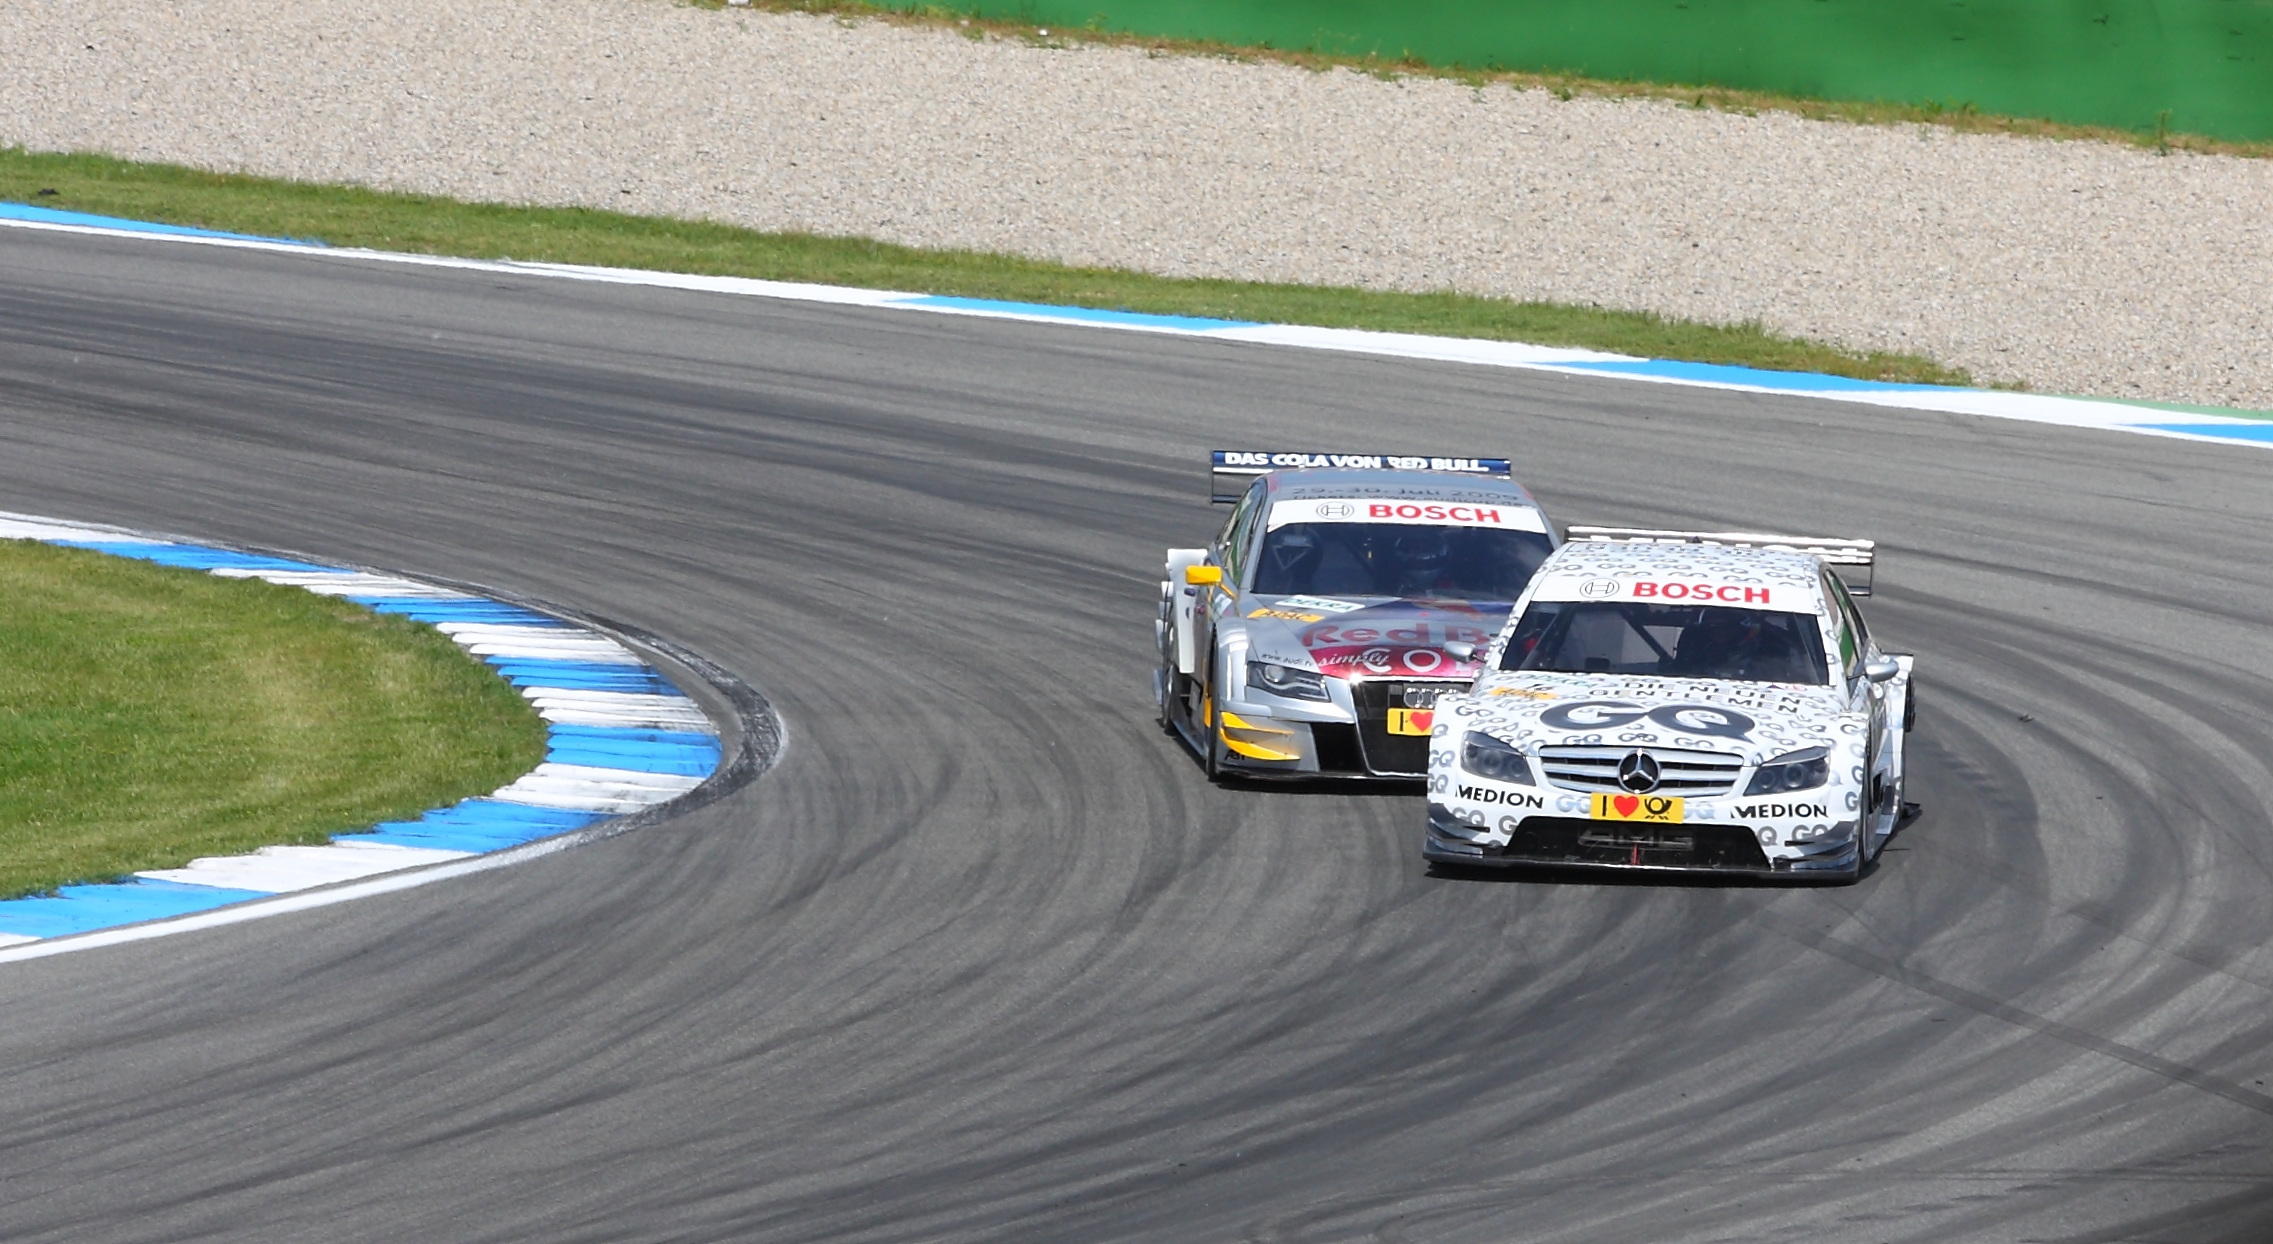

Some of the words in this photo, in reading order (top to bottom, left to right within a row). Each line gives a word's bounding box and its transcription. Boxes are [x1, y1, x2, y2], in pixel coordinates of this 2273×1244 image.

[1225, 452, 1269, 465] DAS
[1272, 454, 1329, 467] COLA
[1331, 455, 1381, 468] VON
[1387, 456, 1428, 469] RED
[1369, 504, 1501, 523] BOSCH
[1633, 582, 1770, 604] BOSCH
[1302, 623, 1430, 647] Red
[1318, 652, 1389, 667] simply
[1624, 682, 1675, 691] DIE
[1399, 711, 1405, 731] I
[1540, 701, 1757, 745] GQ
[1455, 784, 1544, 809] MEDION
[1602, 795, 1607, 817] I
[1730, 803, 1829, 818] MEDION
